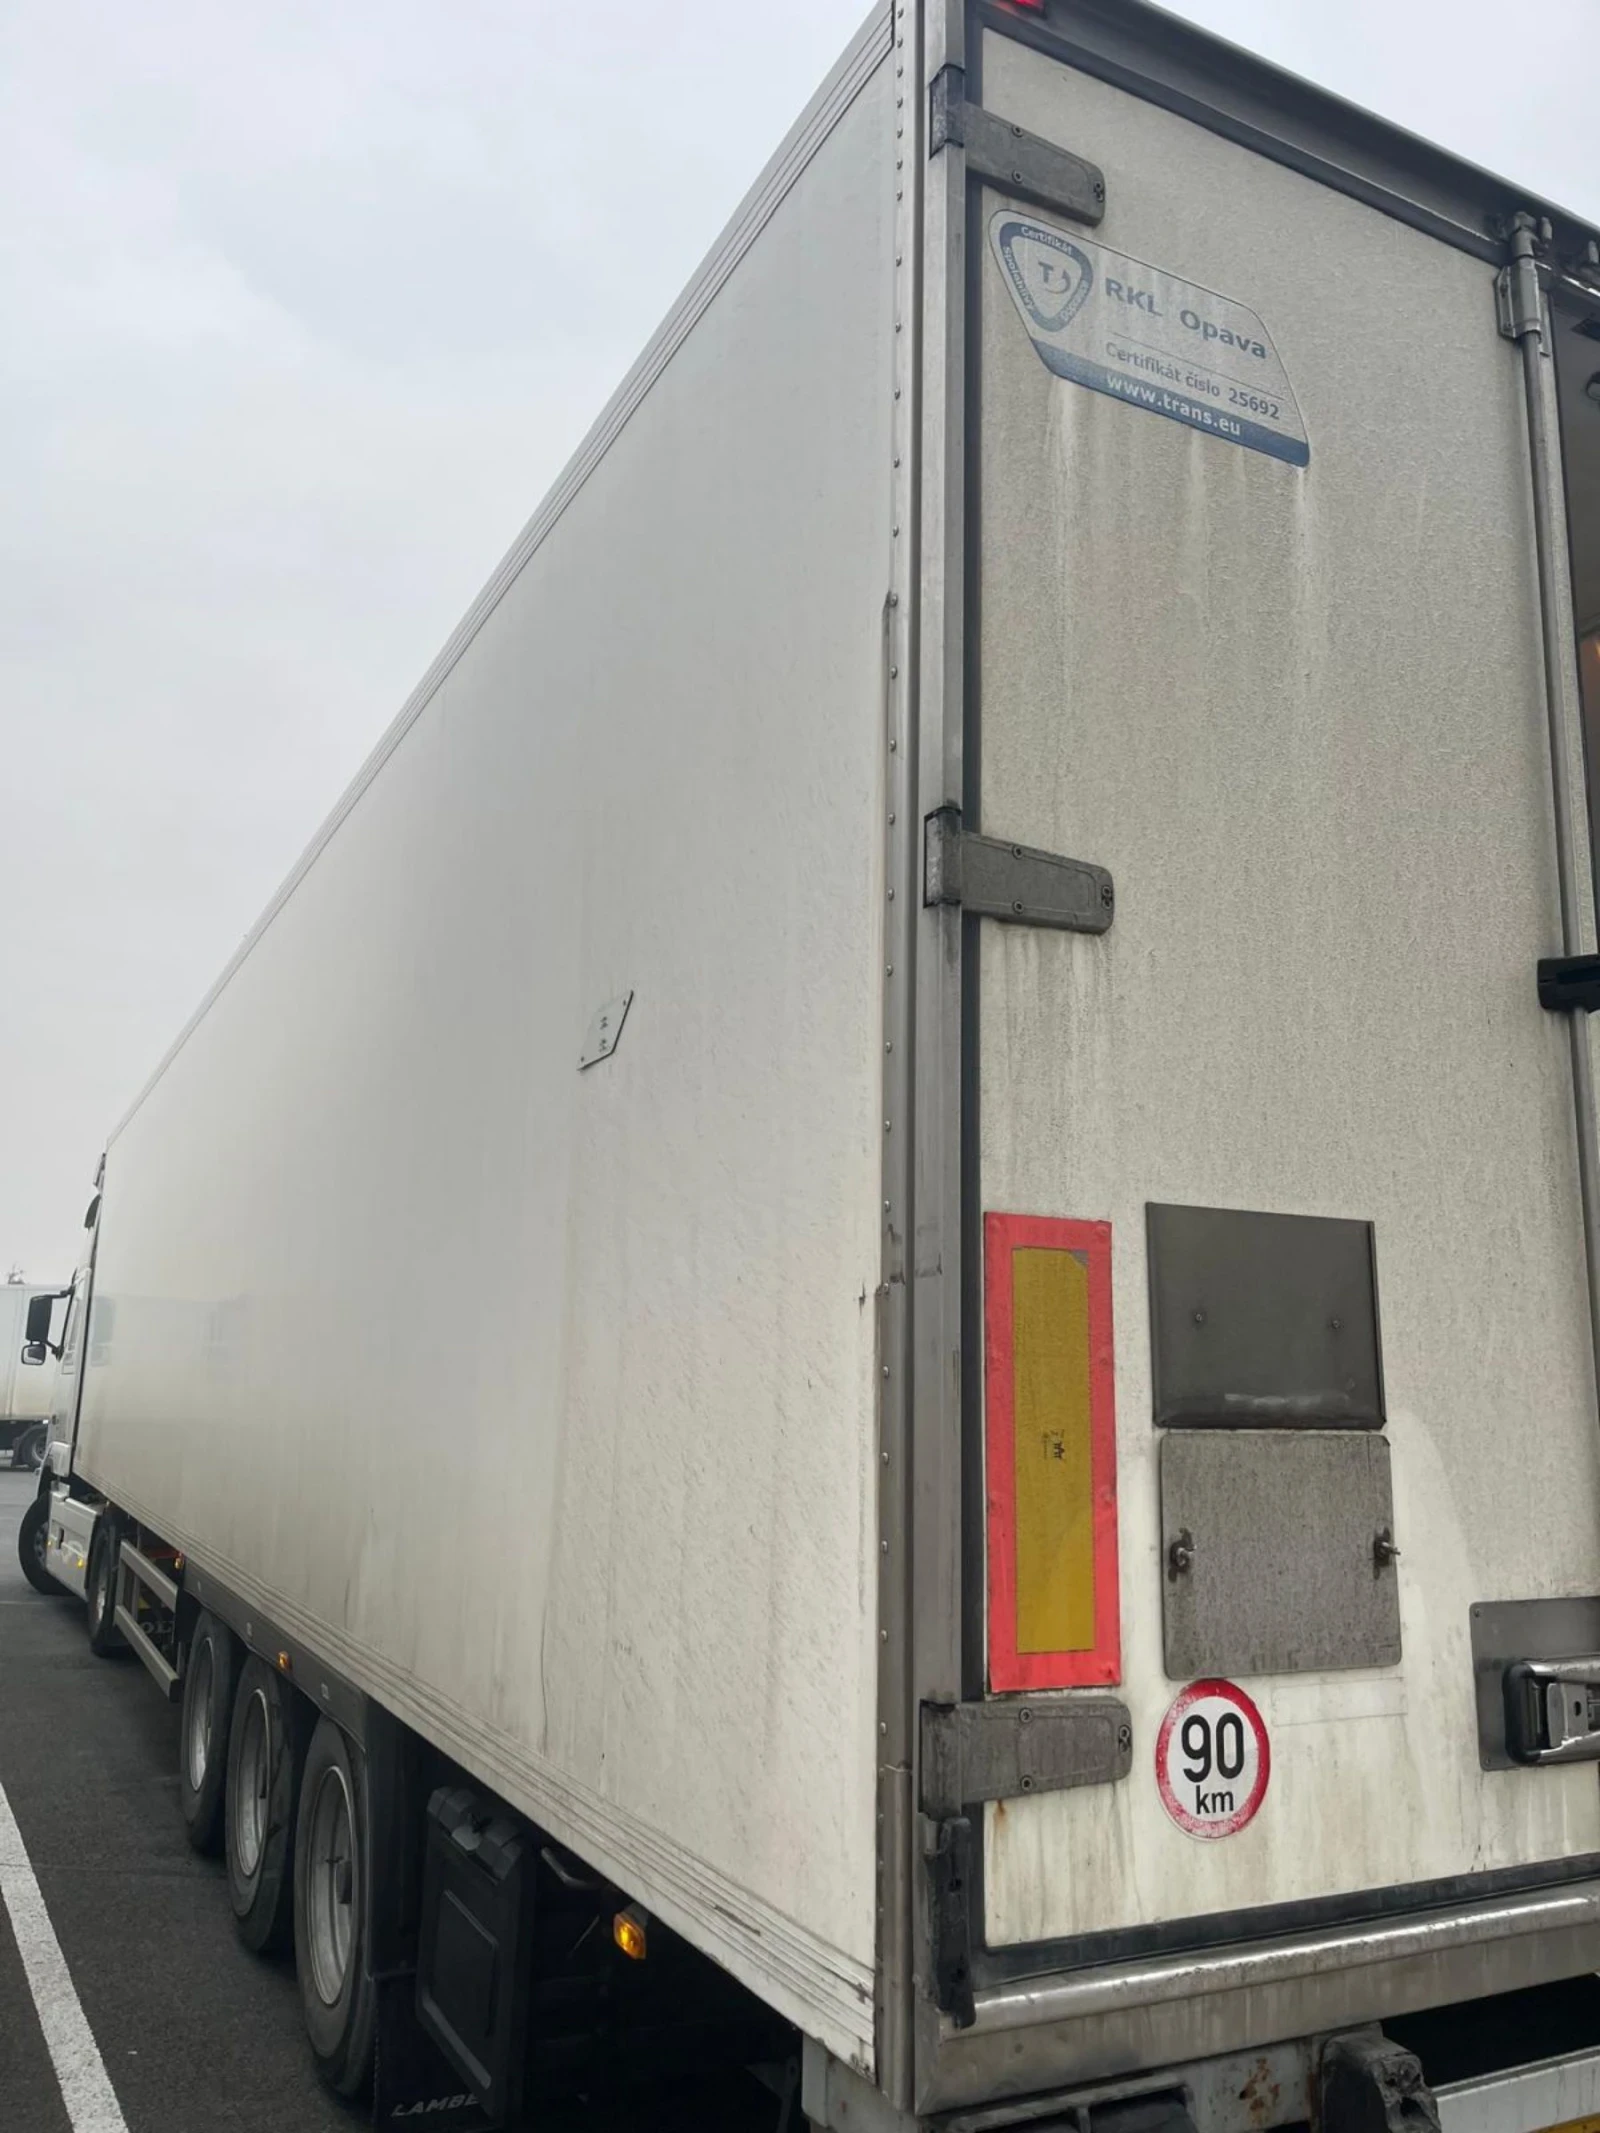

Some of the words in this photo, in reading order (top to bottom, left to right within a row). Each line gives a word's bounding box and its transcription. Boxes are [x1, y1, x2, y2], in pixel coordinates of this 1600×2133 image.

[1105, 276, 1164, 318] RKL
[1179, 308, 1267, 360] Opava
[1105, 341, 1182, 383] Certifikát
[1185, 370, 1221, 398] číslo
[1227, 386, 1281, 421] 25692
[1106, 373, 1242, 437] www.trans.eu
[1181, 1712, 1245, 1783] 90
[1195, 1784, 1235, 1815] km
